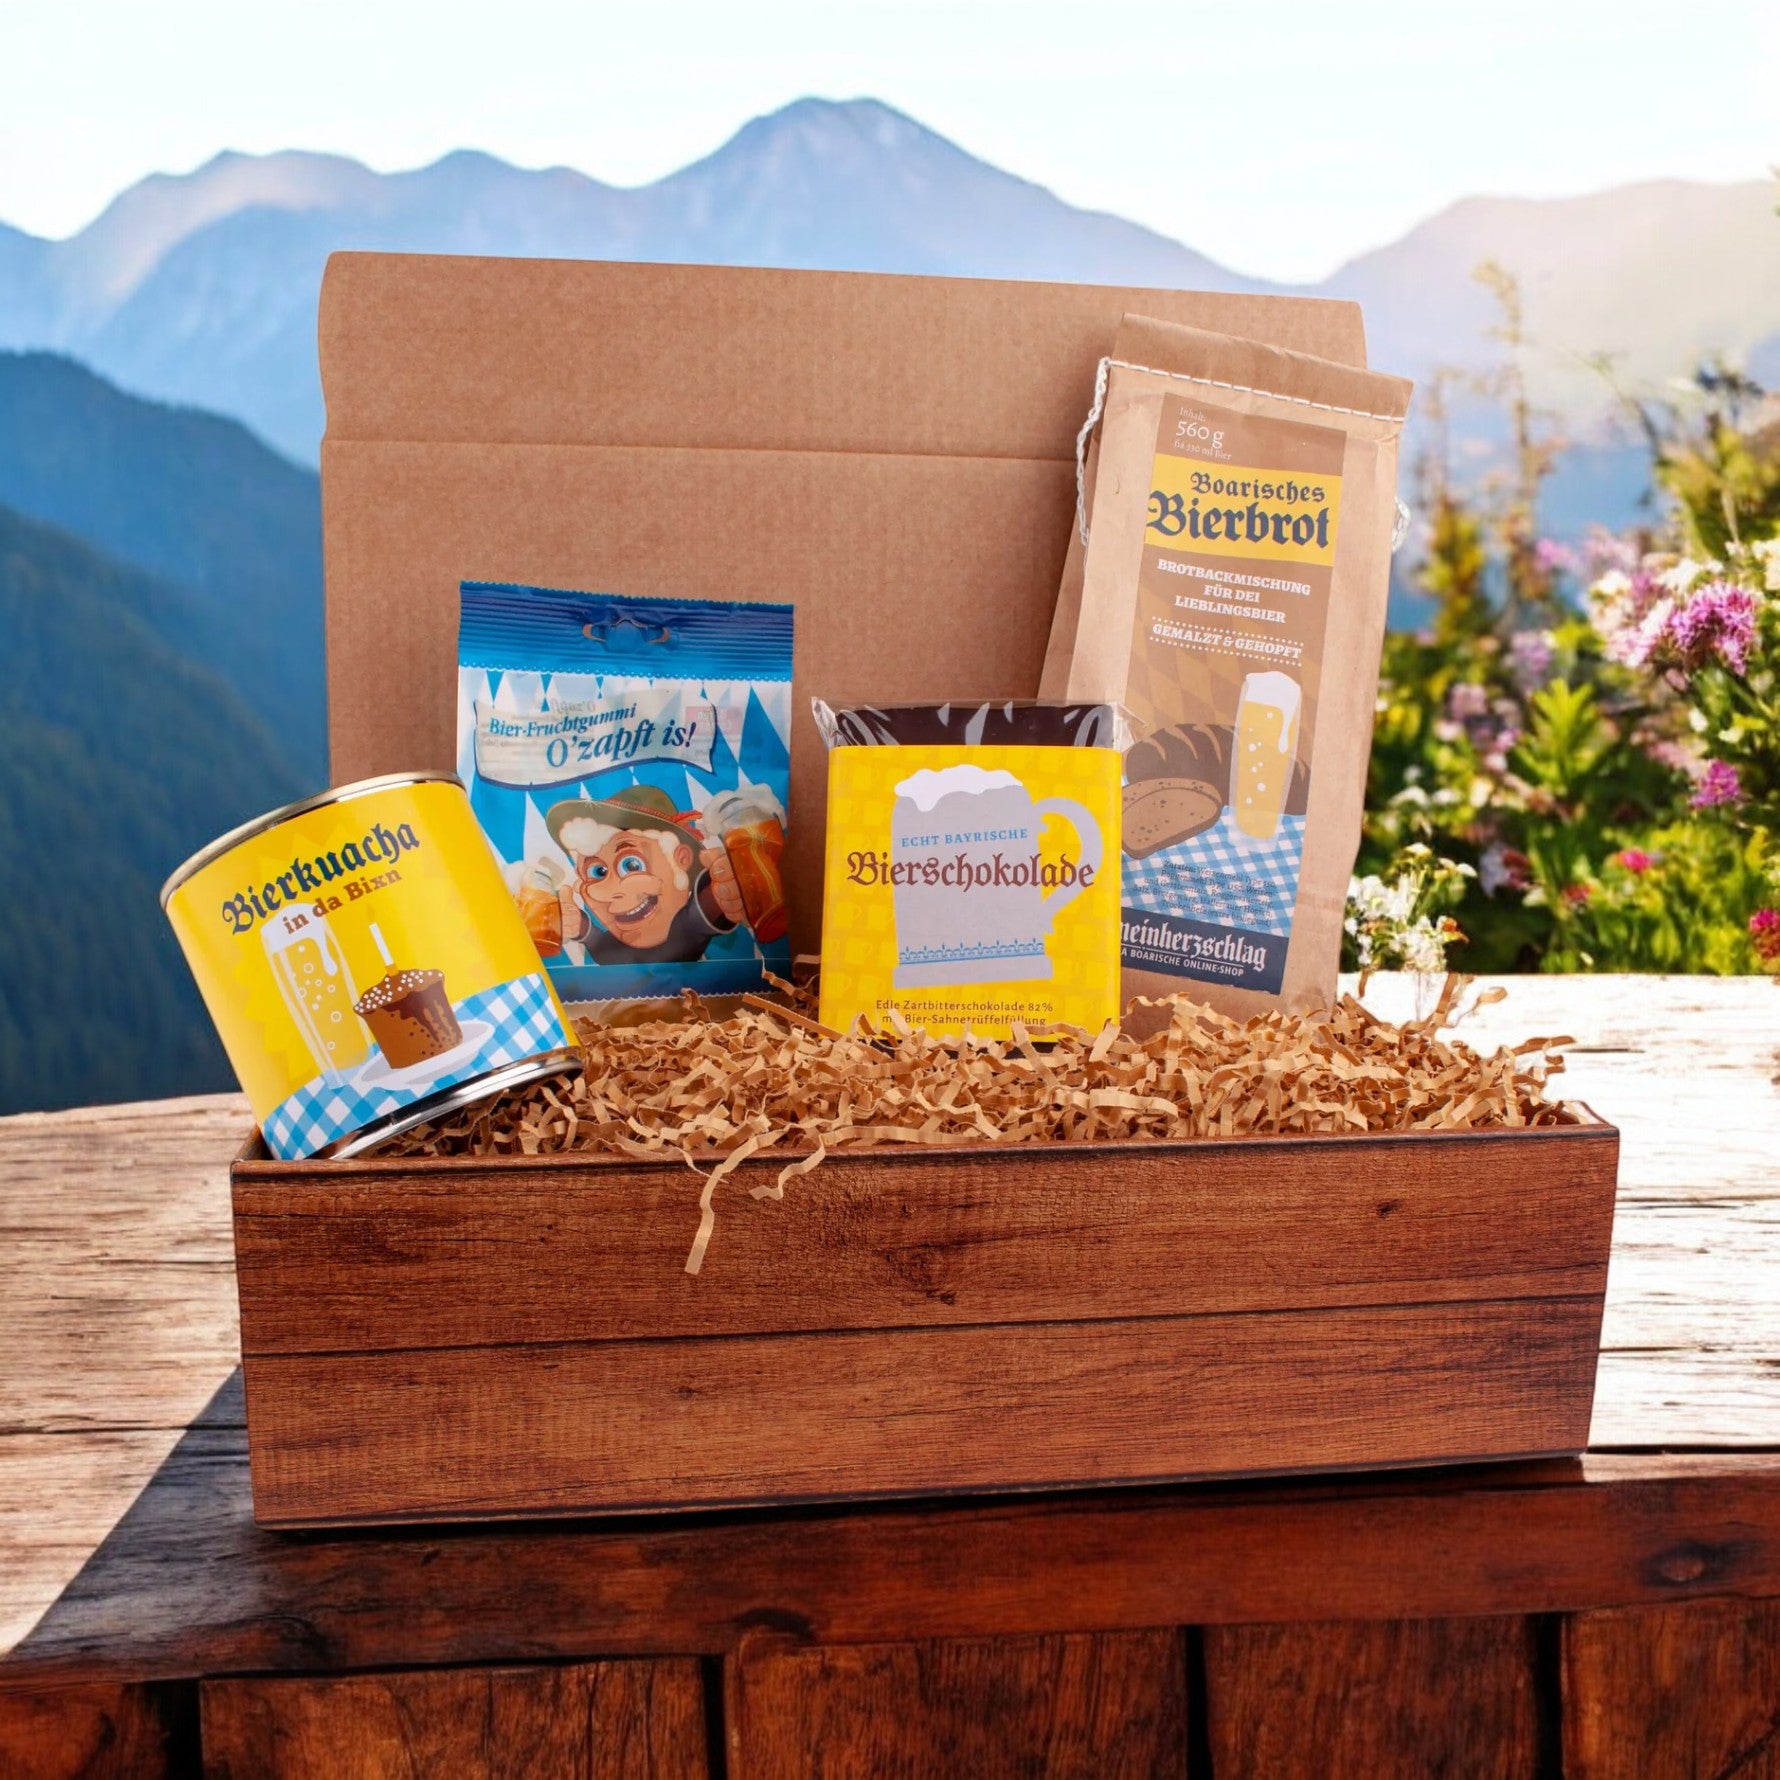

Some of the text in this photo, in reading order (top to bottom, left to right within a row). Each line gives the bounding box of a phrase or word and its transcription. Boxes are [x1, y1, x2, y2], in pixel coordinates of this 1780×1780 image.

[1175, 421, 1225, 449] 560 g
[1190, 471, 1326, 505] Boarisches
[1146, 490, 1330, 549] Bierbrot
[1157, 558, 1312, 596] BROTBACKMISCHUNG
[1204, 584, 1260, 603] FÜR DEI
[1174, 595, 1286, 624] LIEBLINGSBIER
[1152, 623, 1302, 659] GEMALZT & GEHOPFT
[488, 703, 637, 738] Bier-Fruchtgummi
[546, 718, 656, 768] O'zapft
[662, 721, 697, 748] is!
[901, 828, 1028, 848] ECHT BAYRISCHE
[222, 823, 420, 936] Bierkuacha
[847, 851, 1095, 892] Bierschokolade
[283, 869, 402, 934] in da Bixn
[1130, 949, 1181, 966] BOARISCHE
[876, 1000, 1054, 1013] Edle Zartbitterschokolade 82%
